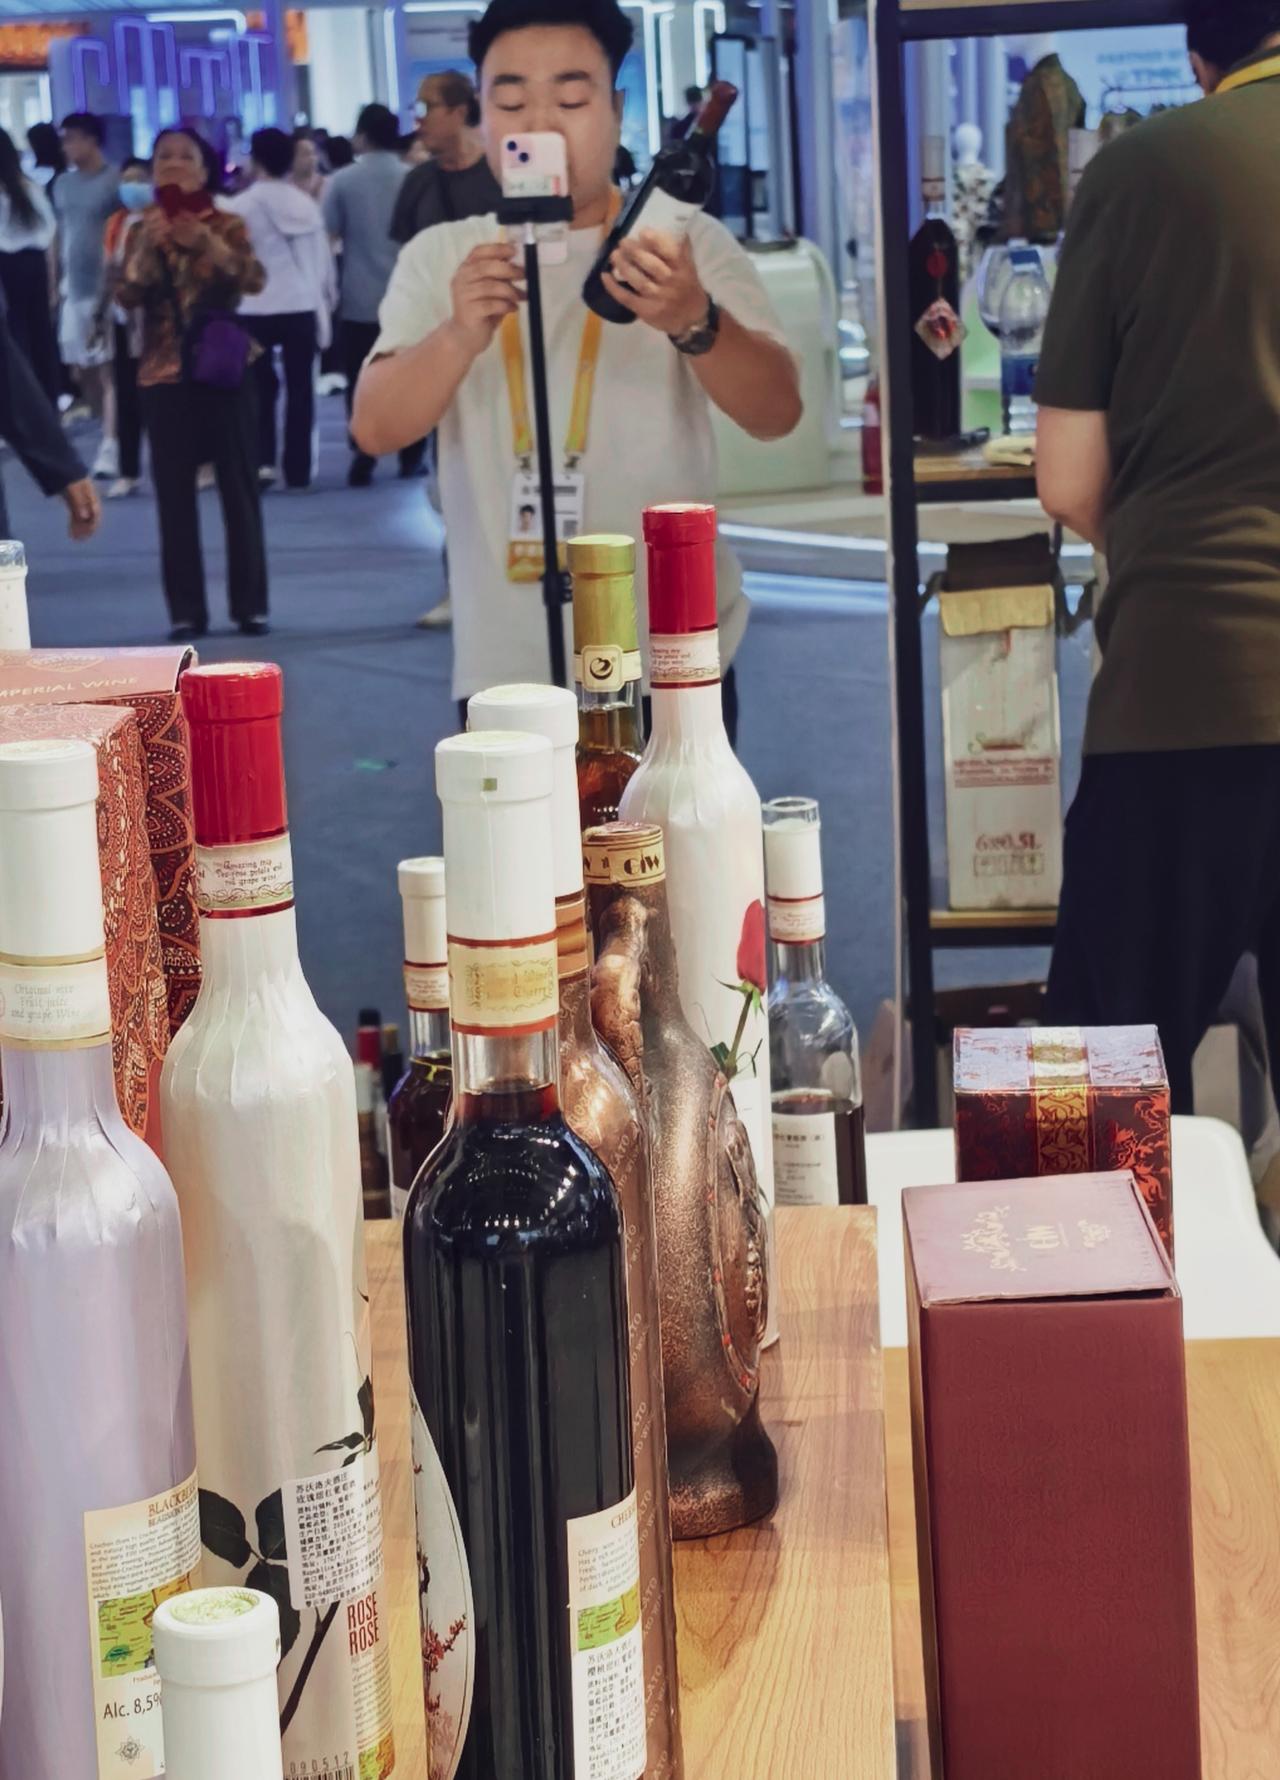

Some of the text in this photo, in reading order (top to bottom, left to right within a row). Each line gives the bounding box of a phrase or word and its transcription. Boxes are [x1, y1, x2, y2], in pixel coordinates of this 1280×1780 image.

[347, 1591, 378, 1630] ROSE
[349, 1617, 380, 1656] ROSE
[103, 1701, 130, 1719] Alc.
